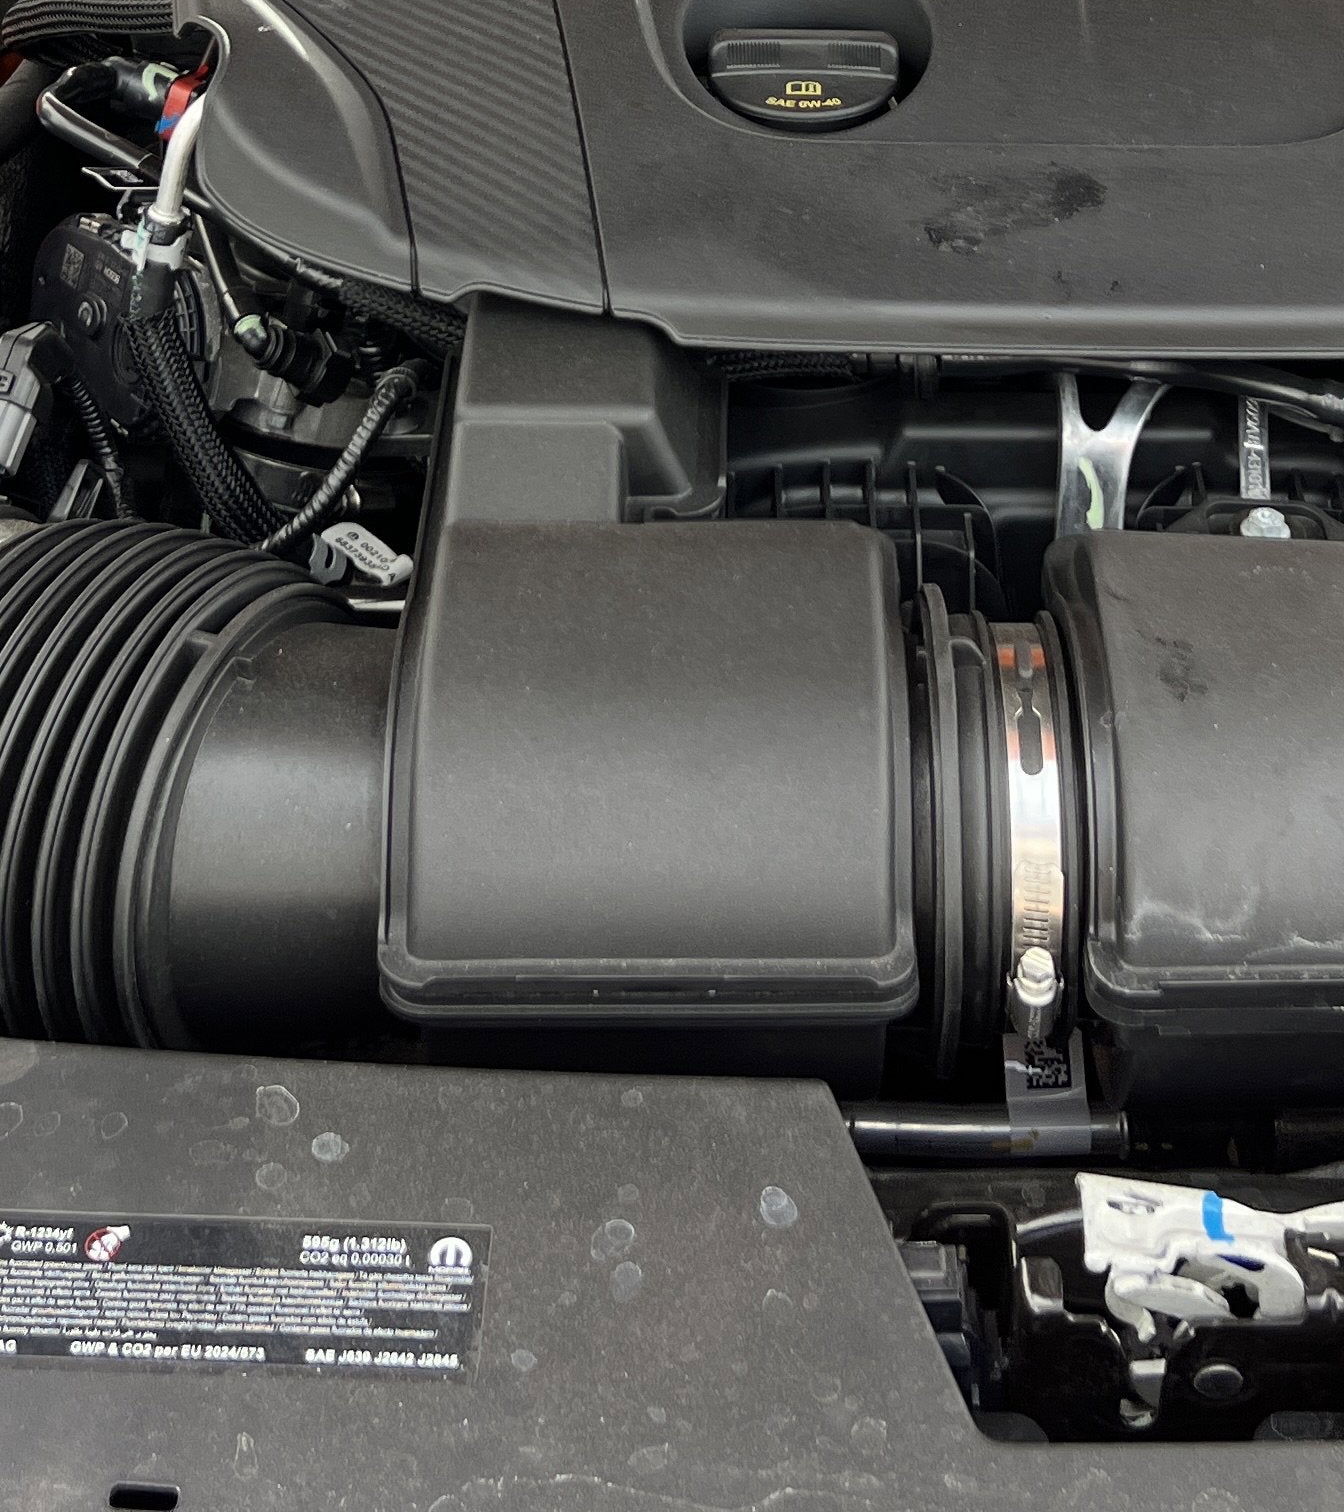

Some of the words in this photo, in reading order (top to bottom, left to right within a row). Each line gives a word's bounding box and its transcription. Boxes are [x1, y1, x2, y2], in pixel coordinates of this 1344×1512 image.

[765, 96, 796, 108] SAE
[798, 97, 842, 109] 0W-40
[15, 1225, 73, 1241] R-1234yf
[11, 1239, 43, 1254] GWP
[299, 1250, 329, 1265] CO2
[69, 1339, 105, 1356] GWP
[107, 1341, 118, 1356] &
[121, 1342, 152, 1357] CO2
[153, 1344, 179, 1359] per
[180, 1344, 201, 1359] EU
[305, 1348, 336, 1363] SAE
